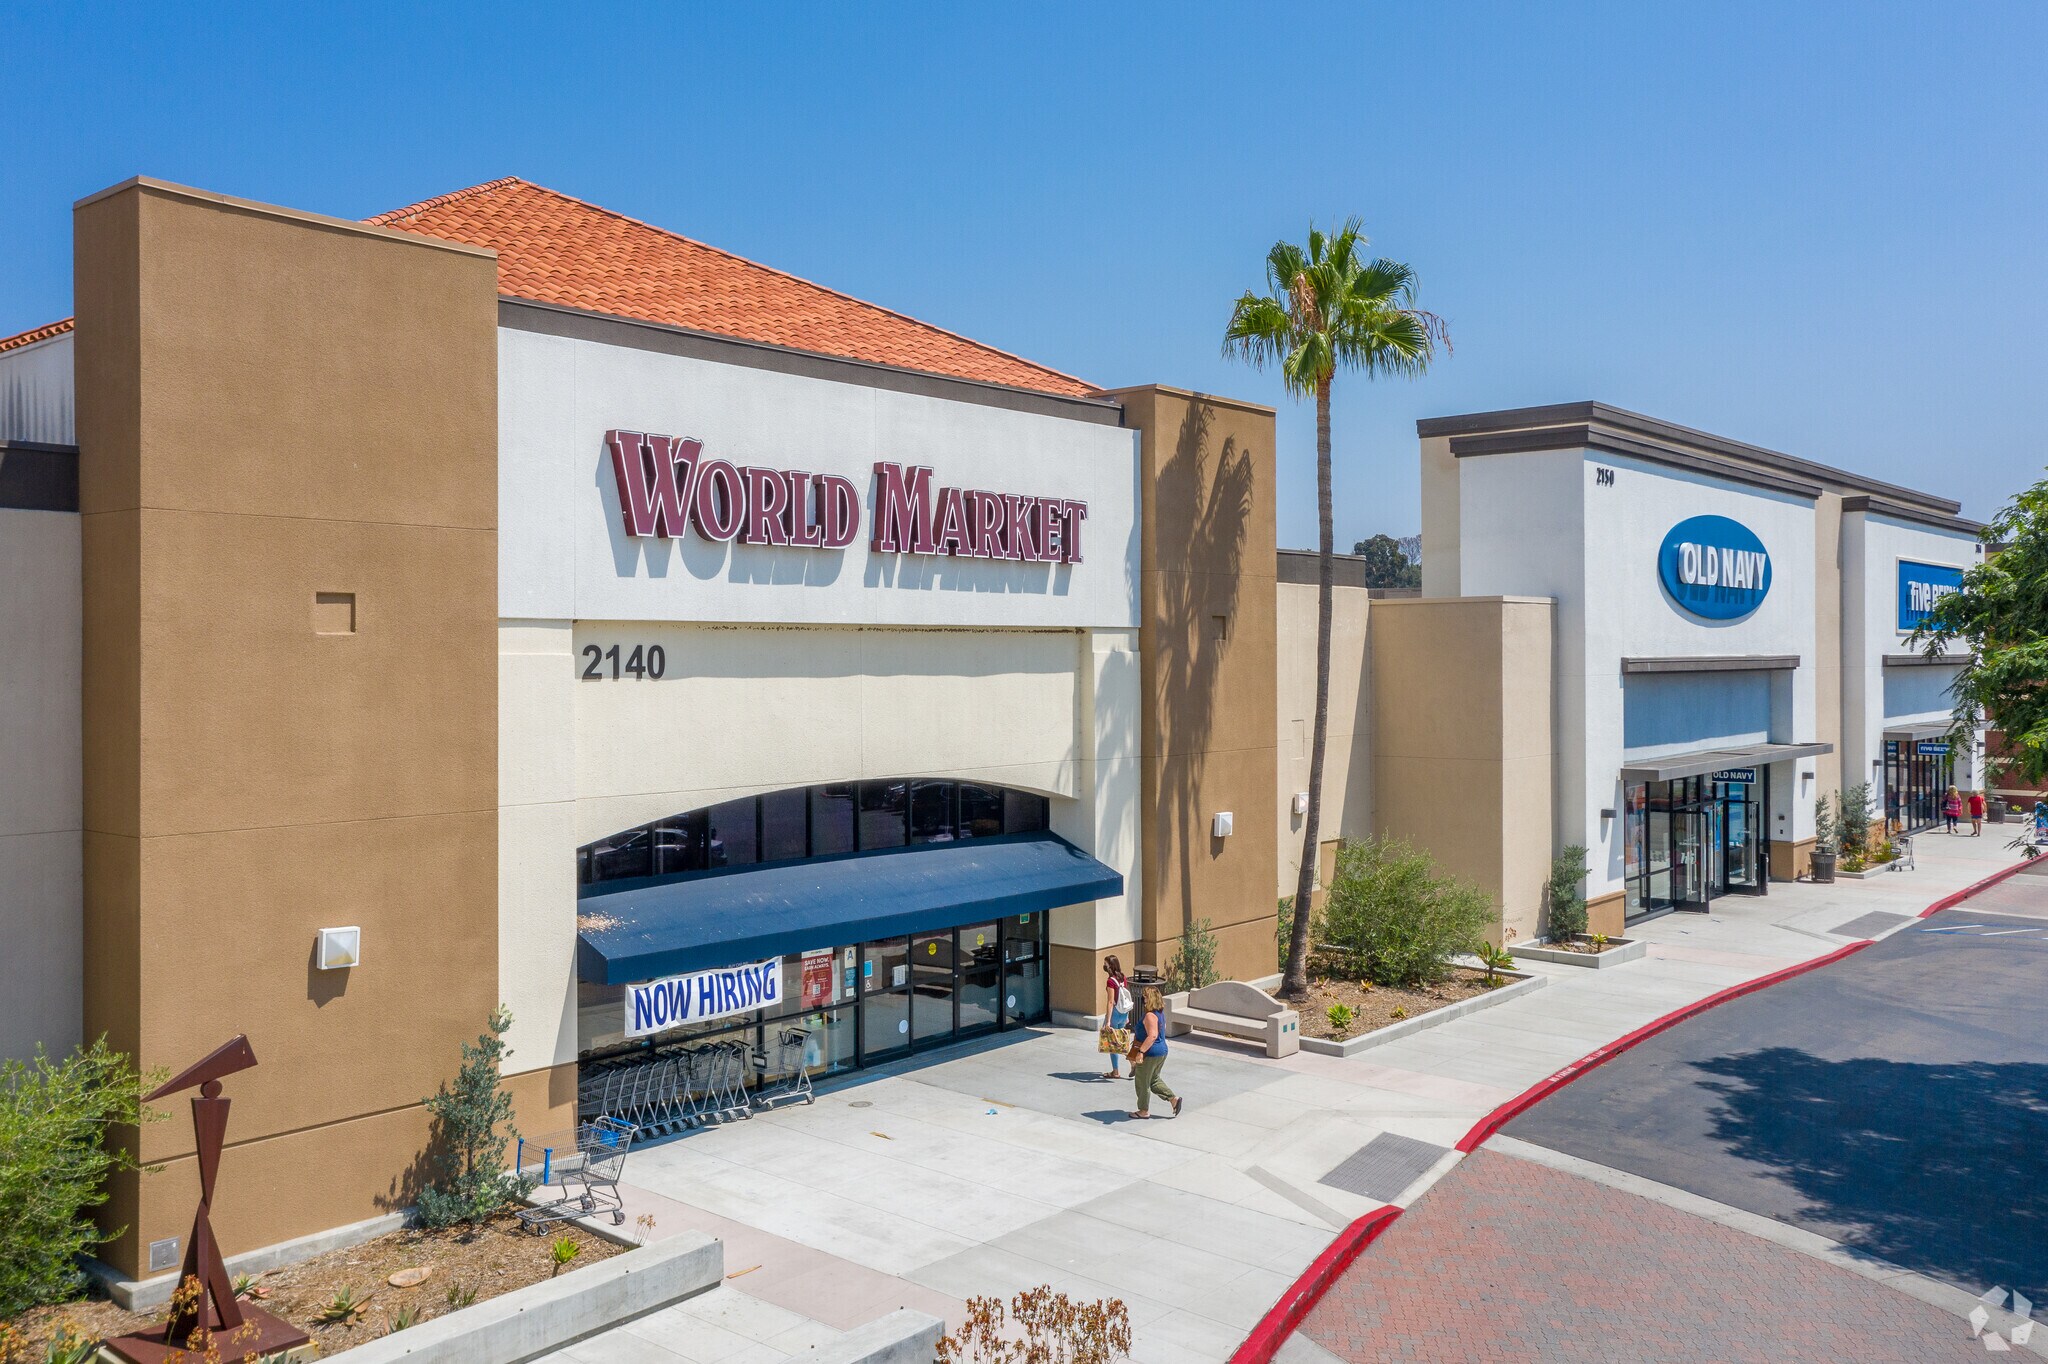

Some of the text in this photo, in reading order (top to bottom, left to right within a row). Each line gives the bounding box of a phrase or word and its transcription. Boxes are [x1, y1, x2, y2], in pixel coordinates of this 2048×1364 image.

[1596, 467, 1615, 487] 2150
[605, 429, 1089, 565] WORLD MARKET
[1679, 541, 1767, 591] OLD NAVY
[581, 644, 666, 681] 2140
[1712, 771, 1753, 780] OLD NAVY
[847, 949, 854, 960] A
[634, 961, 776, 1031] NOW HIRING
